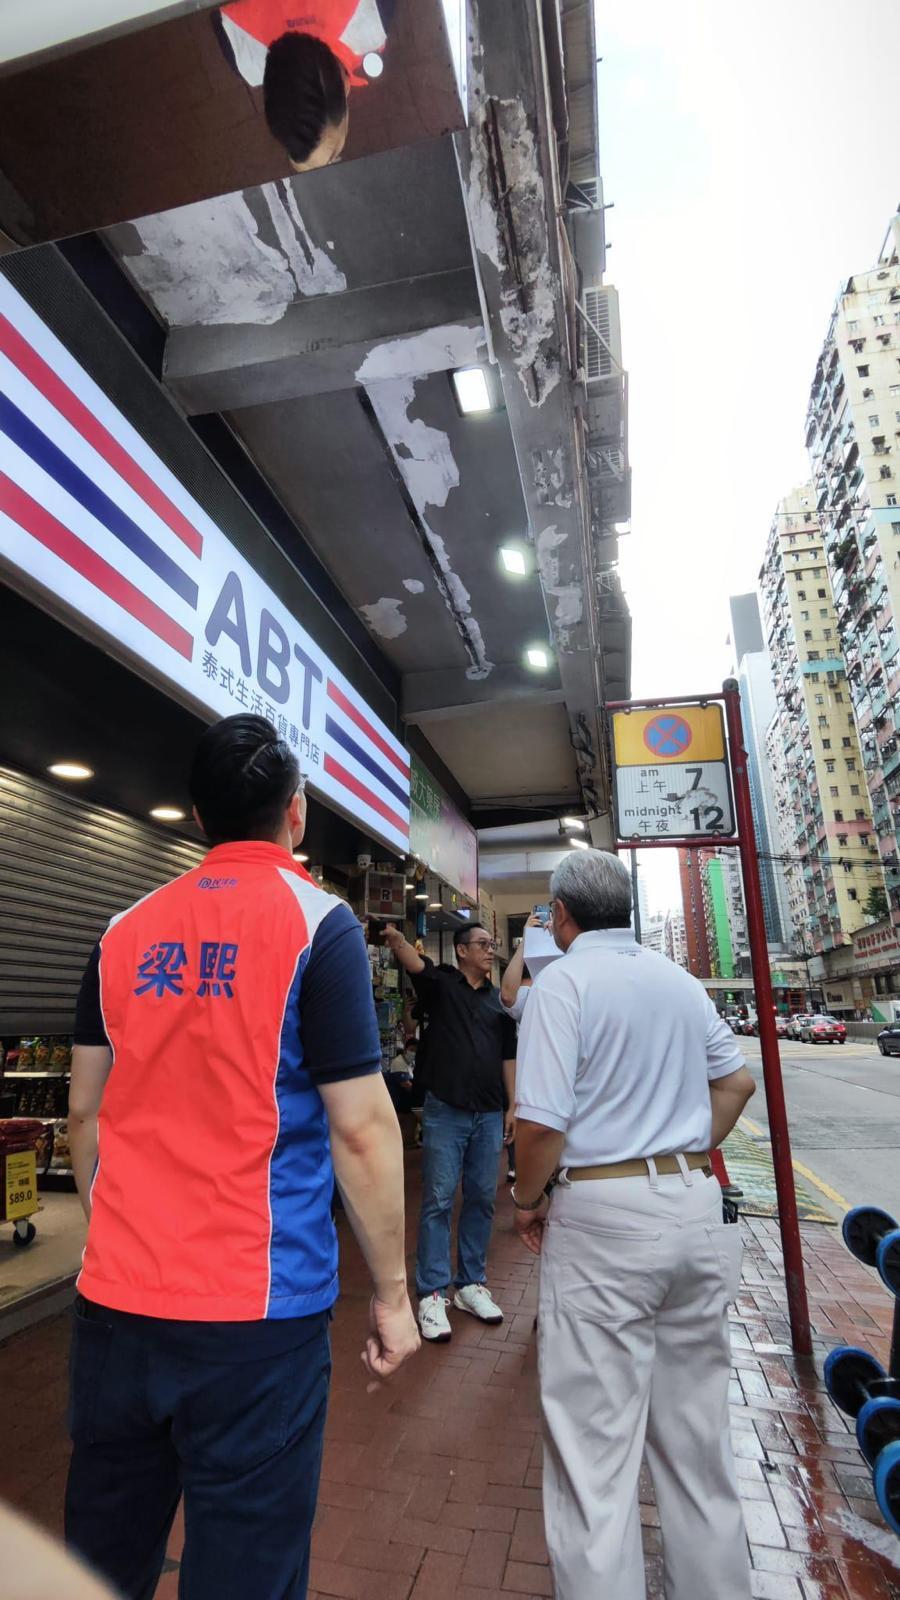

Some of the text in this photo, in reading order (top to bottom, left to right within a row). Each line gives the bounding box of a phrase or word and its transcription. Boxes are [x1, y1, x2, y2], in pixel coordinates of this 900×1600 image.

[204, 570, 323, 731] ABT
[201, 650, 321, 765] 泰式生活百貨專門店
[640, 768, 659, 777] am
[685, 767, 703, 791] 7
[636, 780, 667, 794] 上午
[624, 804, 682, 817] midnight
[689, 806, 724, 830] 12
[638, 819, 670, 833] 午夜
[133, 941, 239, 999] 梁熙
